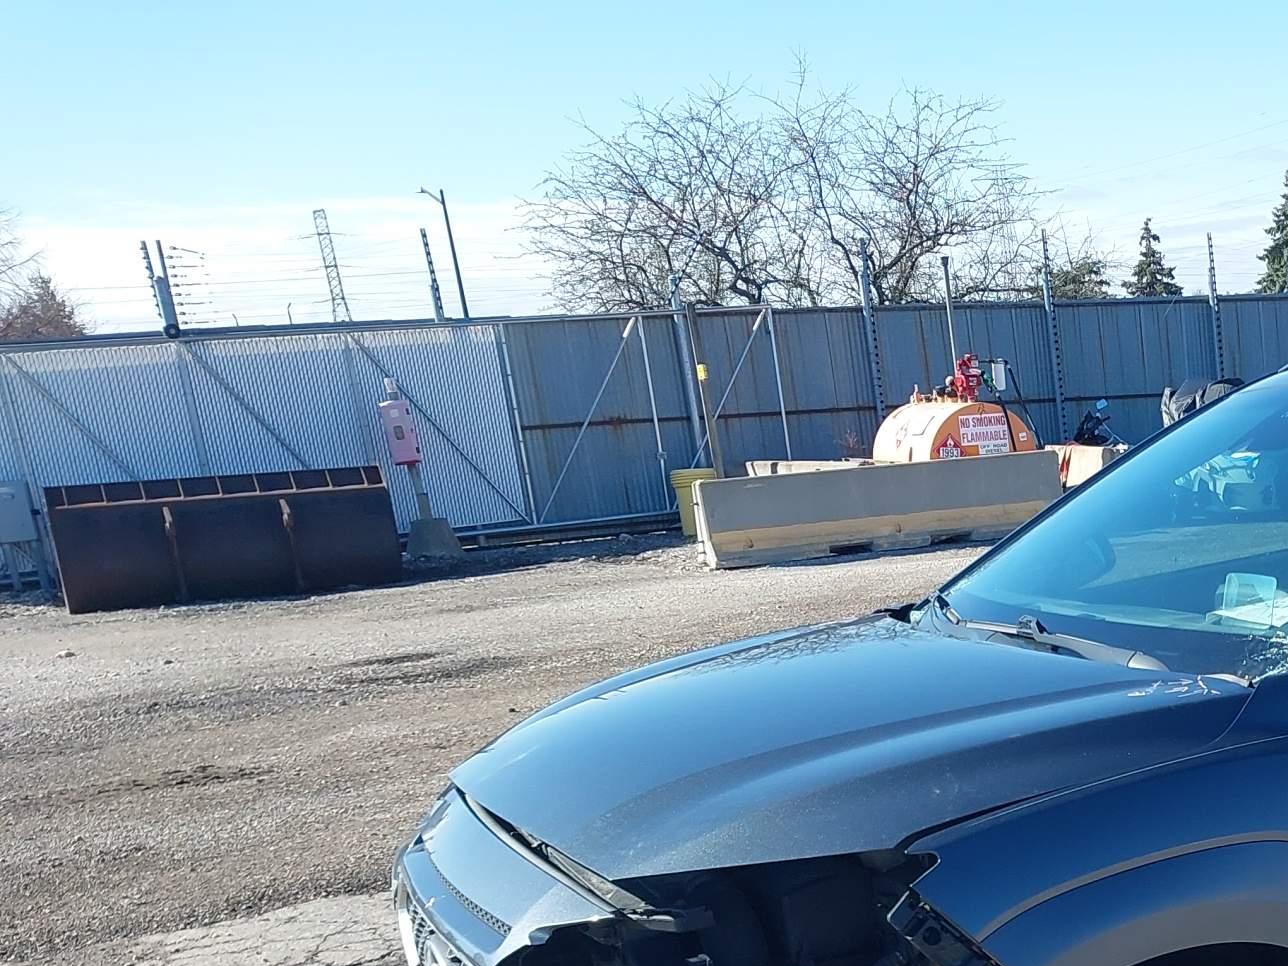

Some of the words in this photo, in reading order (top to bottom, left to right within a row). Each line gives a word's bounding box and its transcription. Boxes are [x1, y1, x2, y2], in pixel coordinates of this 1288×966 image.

[960, 417, 970, 429] NO
[972, 415, 1006, 428] SMOKING
[962, 430, 1008, 443] FLAMMABLE
[942, 448, 959, 457] 1993
